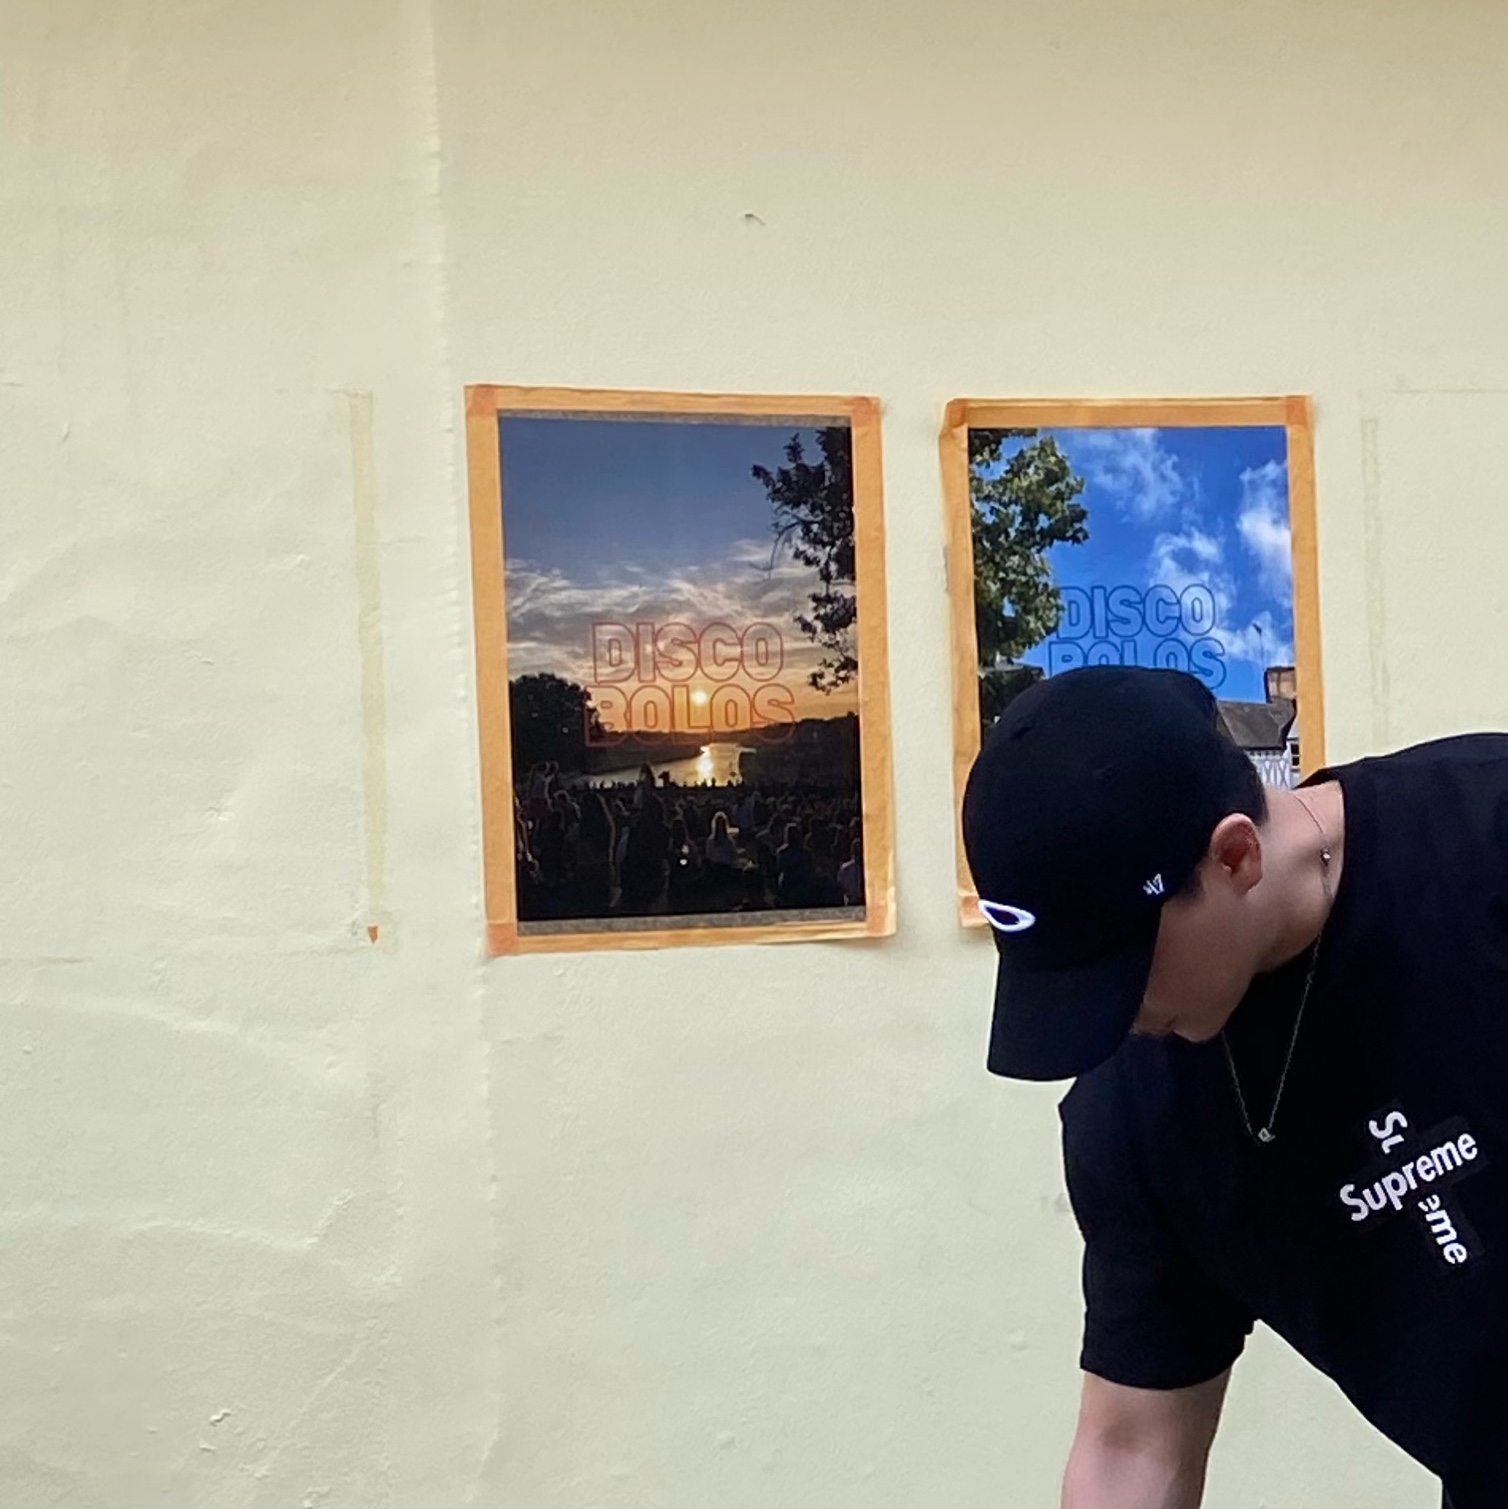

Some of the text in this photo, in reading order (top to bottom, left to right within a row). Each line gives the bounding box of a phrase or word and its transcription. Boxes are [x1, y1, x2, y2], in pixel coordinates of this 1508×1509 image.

[1057, 583, 1215, 640] DISCO
[592, 622, 783, 684] DISCO
[583, 683, 795, 747] BOLOS
[1339, 1133, 1478, 1221] Supreme
